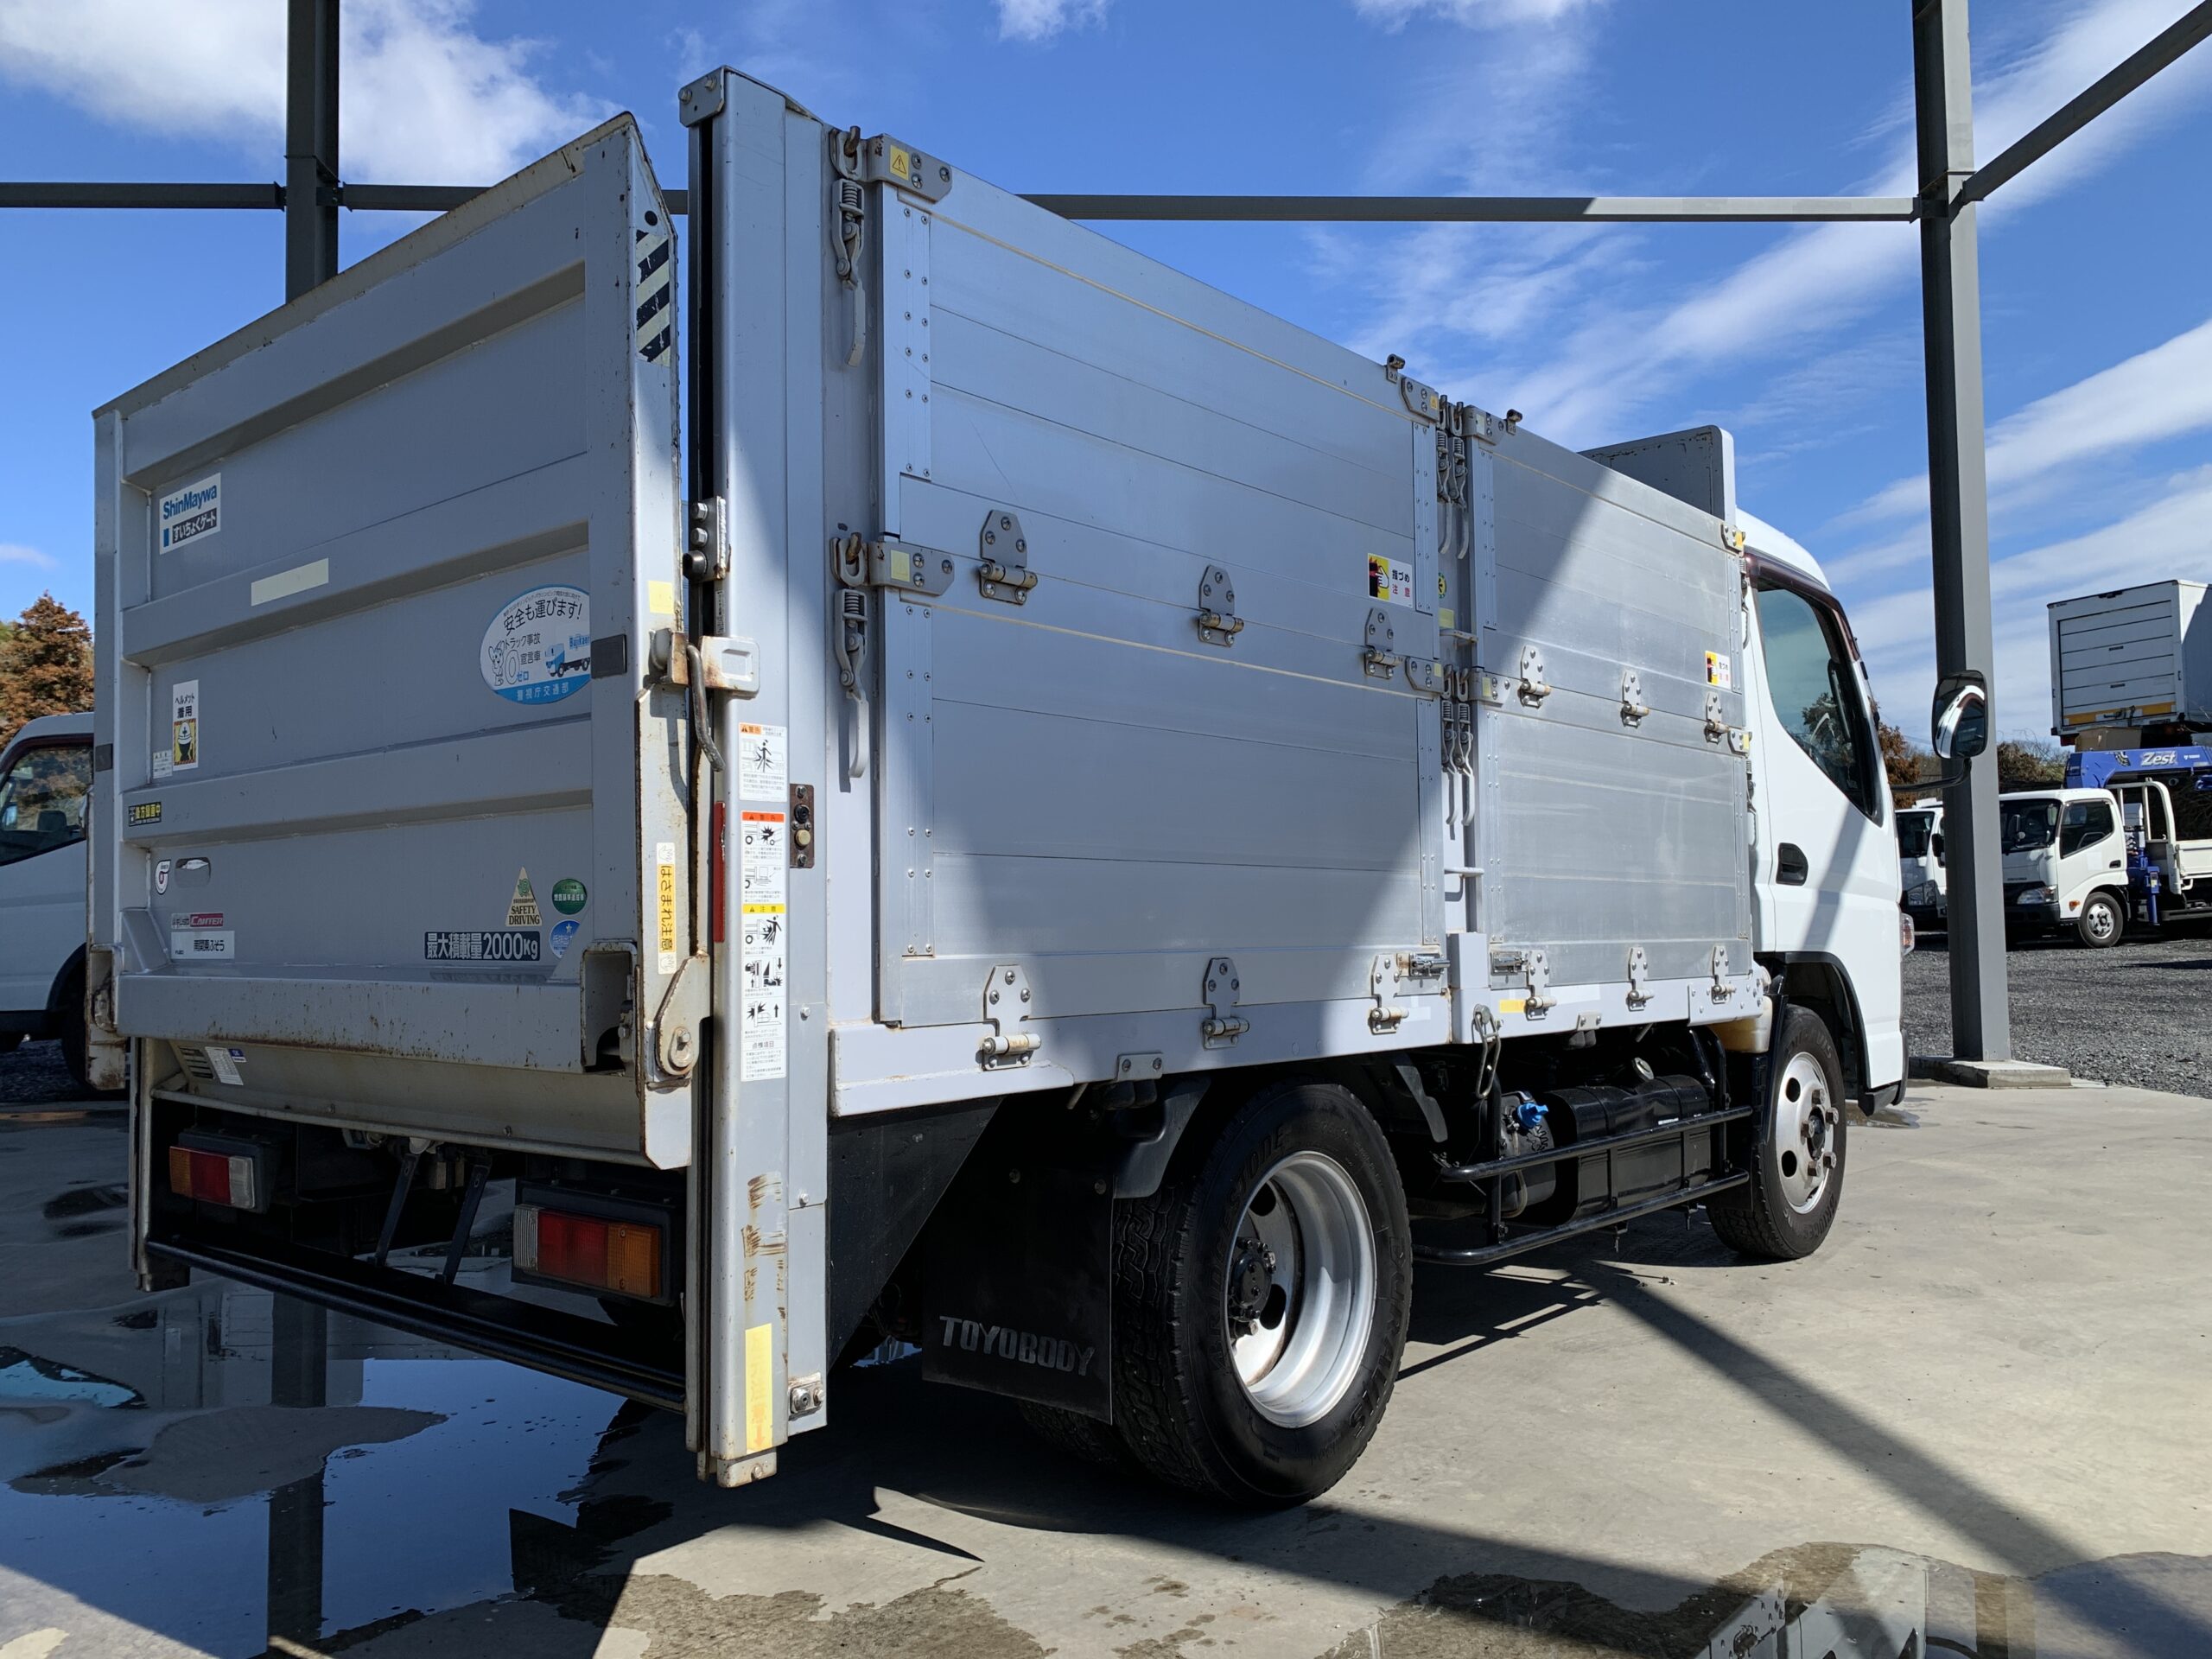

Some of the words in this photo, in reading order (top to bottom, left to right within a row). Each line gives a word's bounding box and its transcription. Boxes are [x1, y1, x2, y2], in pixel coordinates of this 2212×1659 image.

[162, 485, 218, 520] ShinMaywa
[173, 512, 218, 542] すいちょくゲート
[504, 598, 582, 636] 安全も運びます!
[505, 632, 541, 651] トラック事故
[2140, 751, 2177, 766] Zest
[509, 914, 541, 925] DRIVING
[511, 905, 537, 915] SAFETY
[660, 865, 674, 951] はさまれ注意
[938, 1315, 1096, 1377] TOYOBODY
